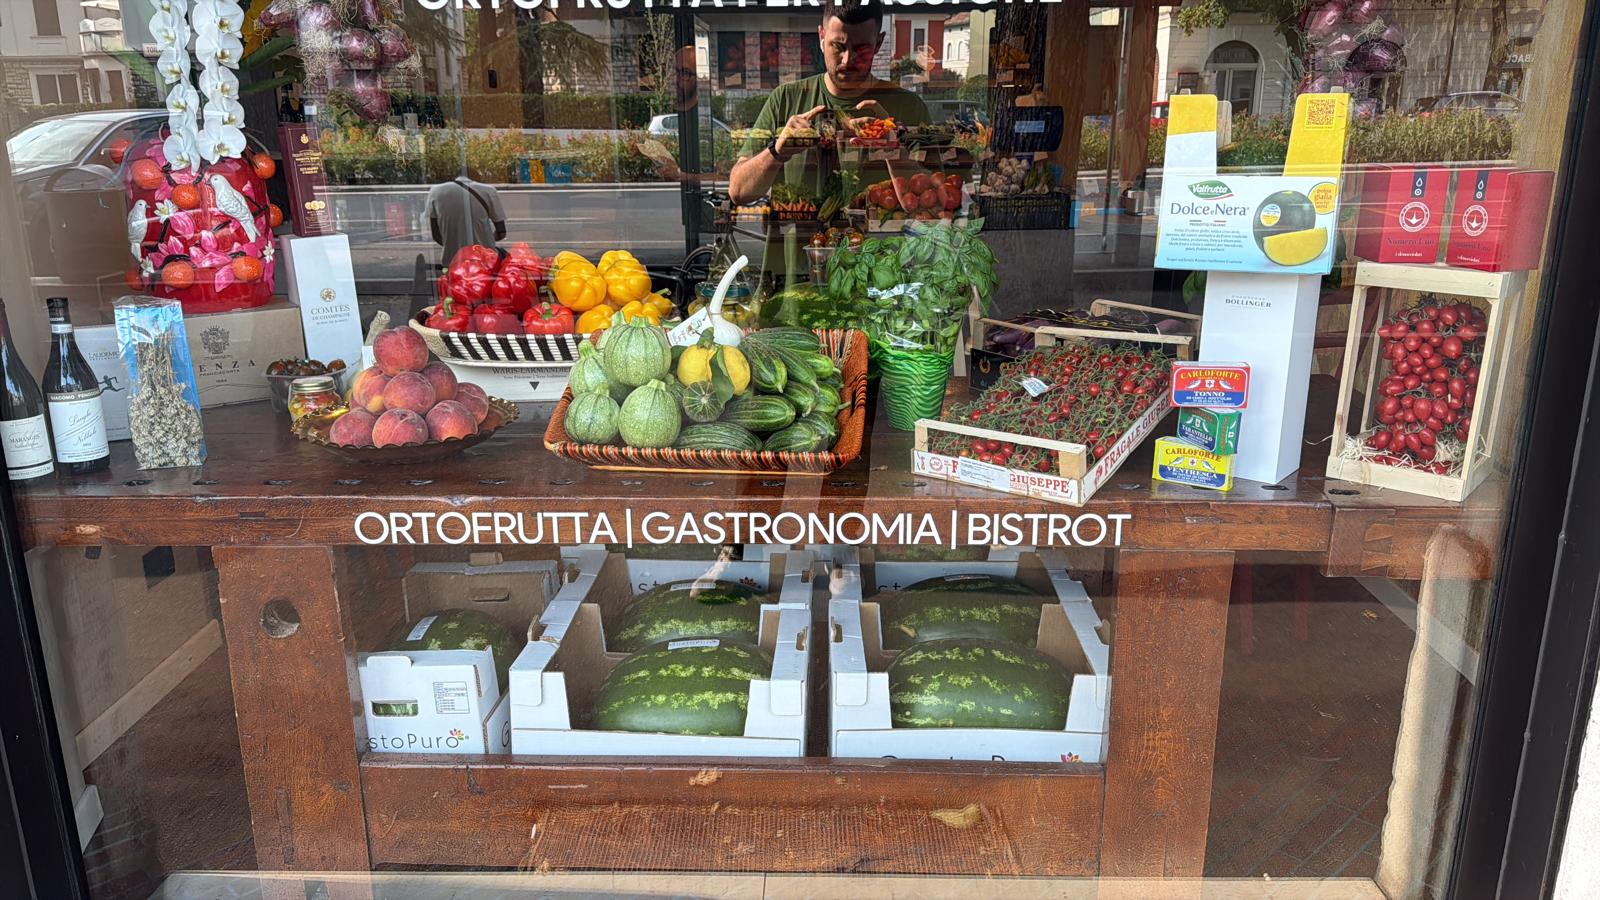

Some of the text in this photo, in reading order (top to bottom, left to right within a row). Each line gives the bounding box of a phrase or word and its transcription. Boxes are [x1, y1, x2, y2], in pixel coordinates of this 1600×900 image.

[1192, 183, 1228, 194] Valfrutta
[1170, 202, 1210, 215] Dolce
[1215, 203, 1246, 216] Nera
[310, 304, 350, 315] COMTES
[1225, 298, 1272, 308] BOLLINGER
[1180, 369, 1240, 380] CARLOFORTE
[1104, 395, 1169, 476] FRAGALE GIUSE
[1165, 448, 1222, 461] CARLOFORTE
[1167, 466, 1217, 478] VENTRESCA
[1009, 473, 1069, 494] GIUSEPPE
[354, 511, 1132, 546] ORTOFRUTTA GASTRONOMIA BISTROT
[368, 733, 459, 750] stoPuro
